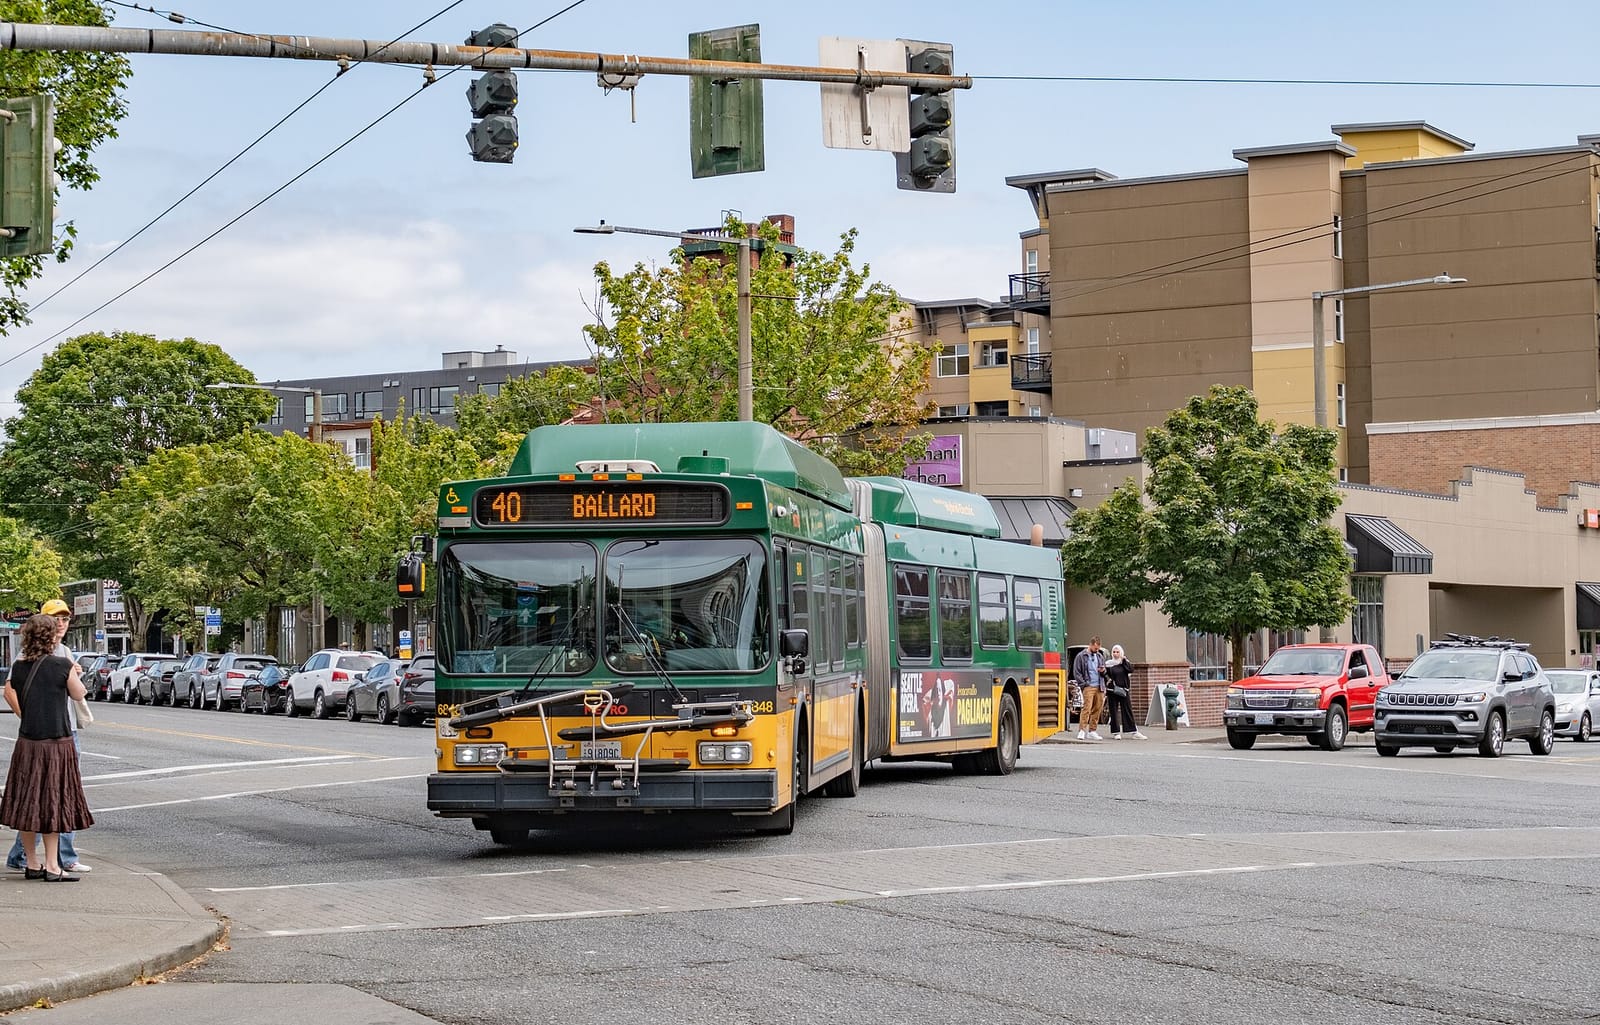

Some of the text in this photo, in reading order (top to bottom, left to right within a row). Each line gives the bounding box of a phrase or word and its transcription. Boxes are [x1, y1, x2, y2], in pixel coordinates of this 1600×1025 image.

[492, 491, 656, 522] 40 BALLARD
[901, 673, 922, 693] SEATTLE
[584, 705, 628, 715] MERO
[957, 698, 991, 725] PAGLIACCI
